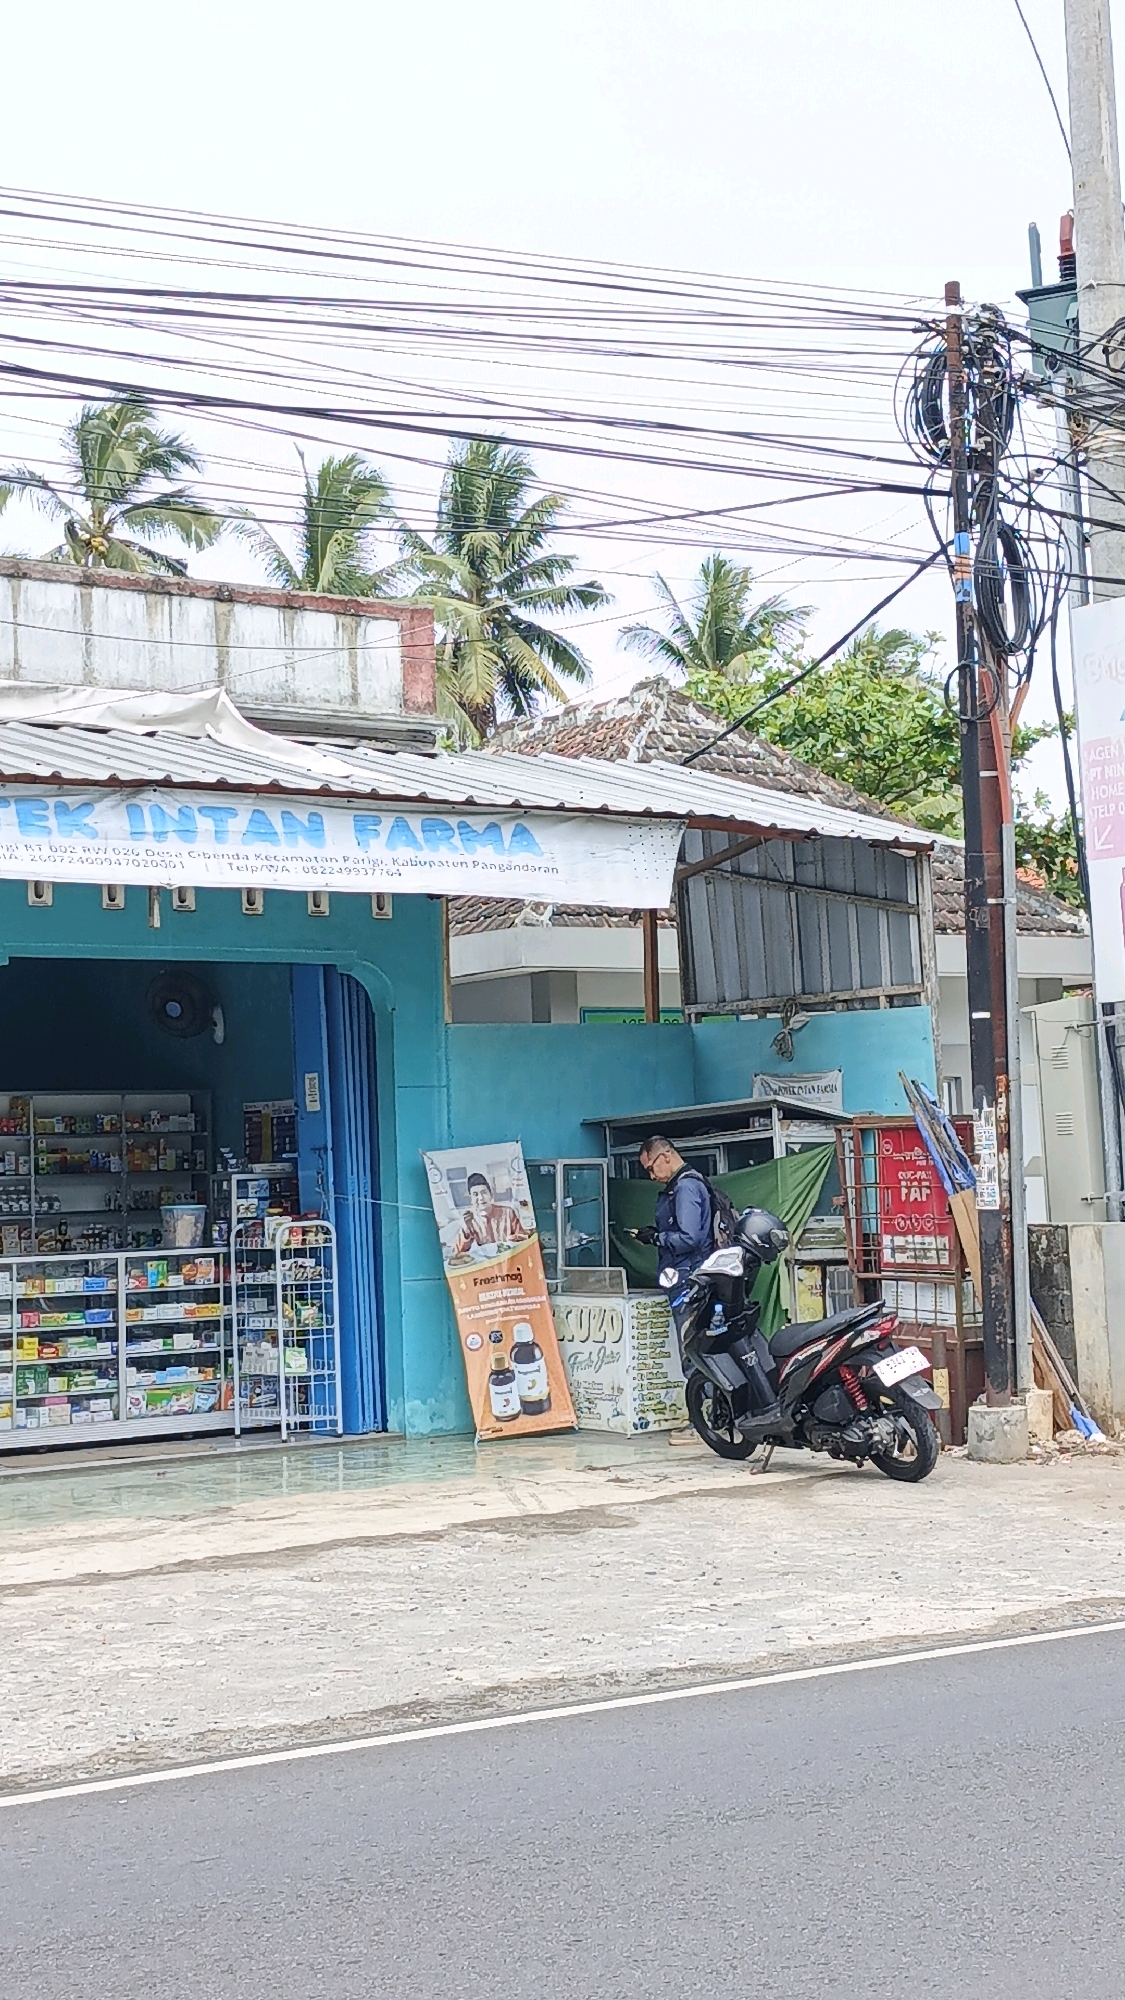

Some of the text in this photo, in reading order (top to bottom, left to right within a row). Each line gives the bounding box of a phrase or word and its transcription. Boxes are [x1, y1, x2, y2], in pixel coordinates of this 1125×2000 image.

[1089, 744, 1119, 762] AGEN
[1091, 803, 1116, 819] TELP
[126, 802, 325, 848] INTAN
[353, 814, 543, 856] FARMA
[24, 844, 42, 853] RT
[49, 844, 77, 854] 002
[82, 845, 108, 855] RW
[112, 847, 140, 857] 026
[145, 849, 183, 859] Desa
[188, 850, 250, 861] Cibenda
[254, 853, 339, 864] Kecamatan
[392, 857, 469, 870] Kabupaten
[472, 860, 560, 874] Pangandaran
